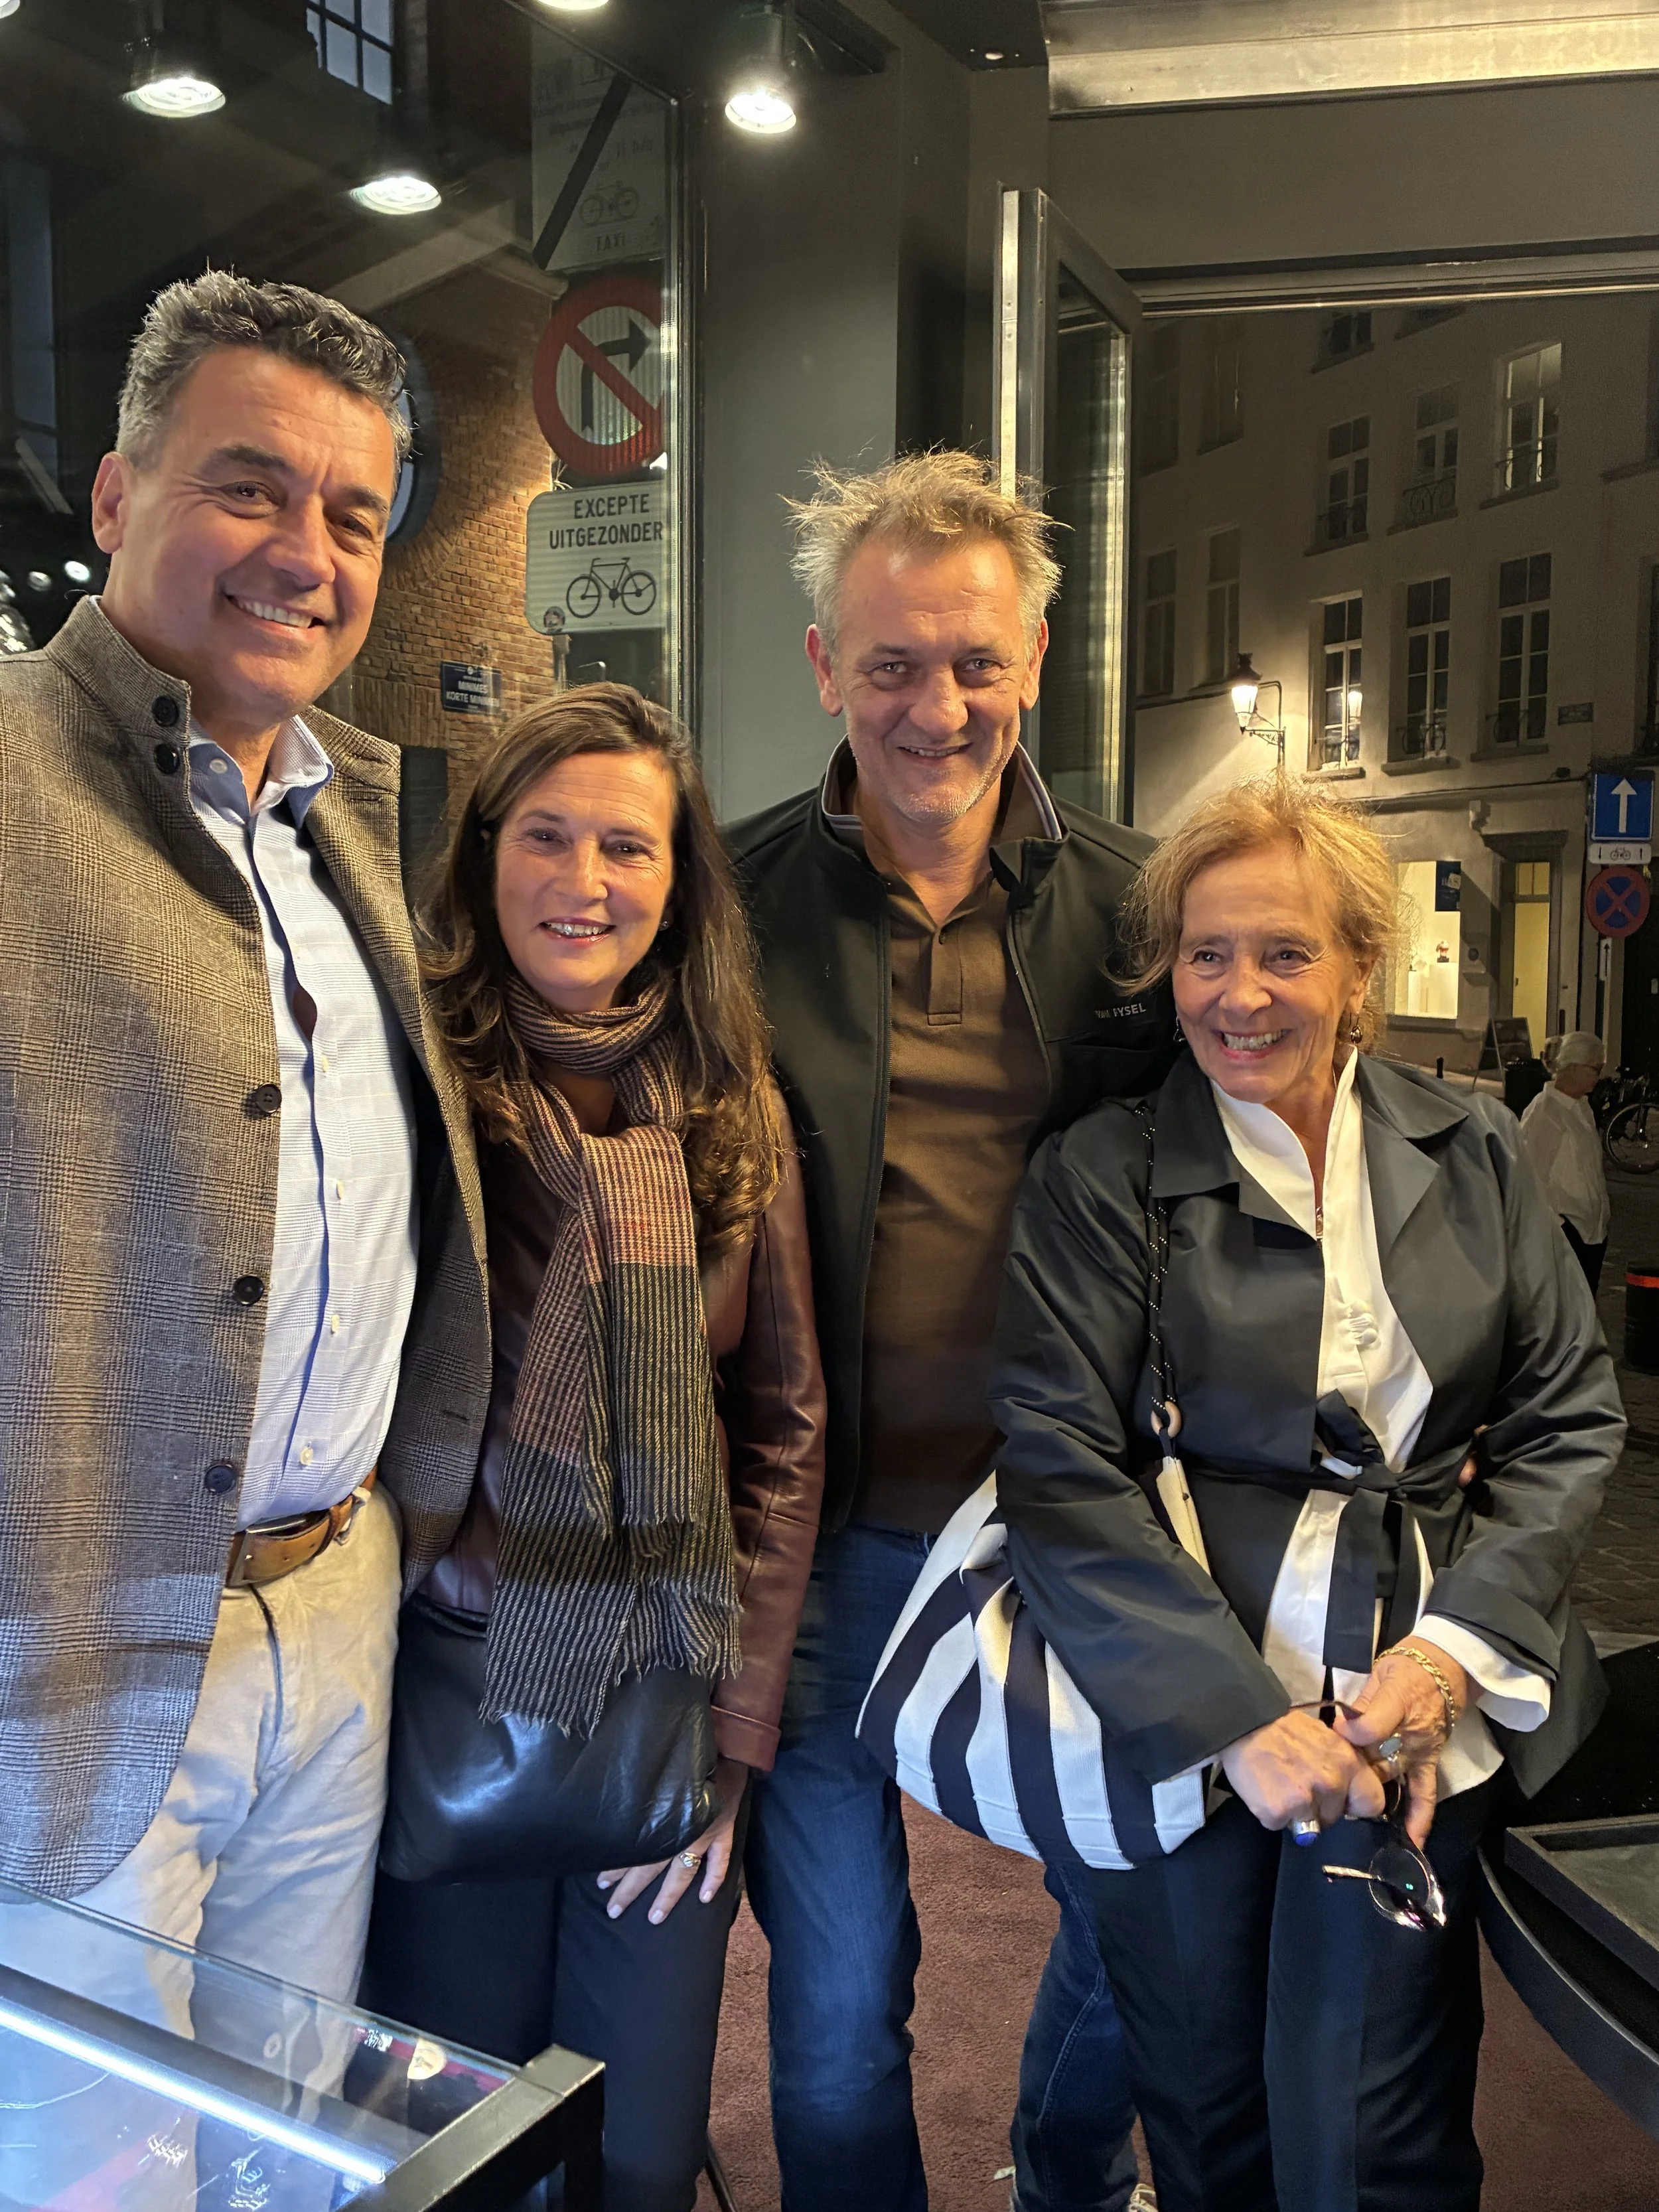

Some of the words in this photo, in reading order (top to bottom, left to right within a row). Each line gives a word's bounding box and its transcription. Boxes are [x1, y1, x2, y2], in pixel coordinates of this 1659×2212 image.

[596, 232, 625, 252] TAXI
[573, 493, 650, 519] EXCEPTE
[446, 691, 469, 703] KORTE
